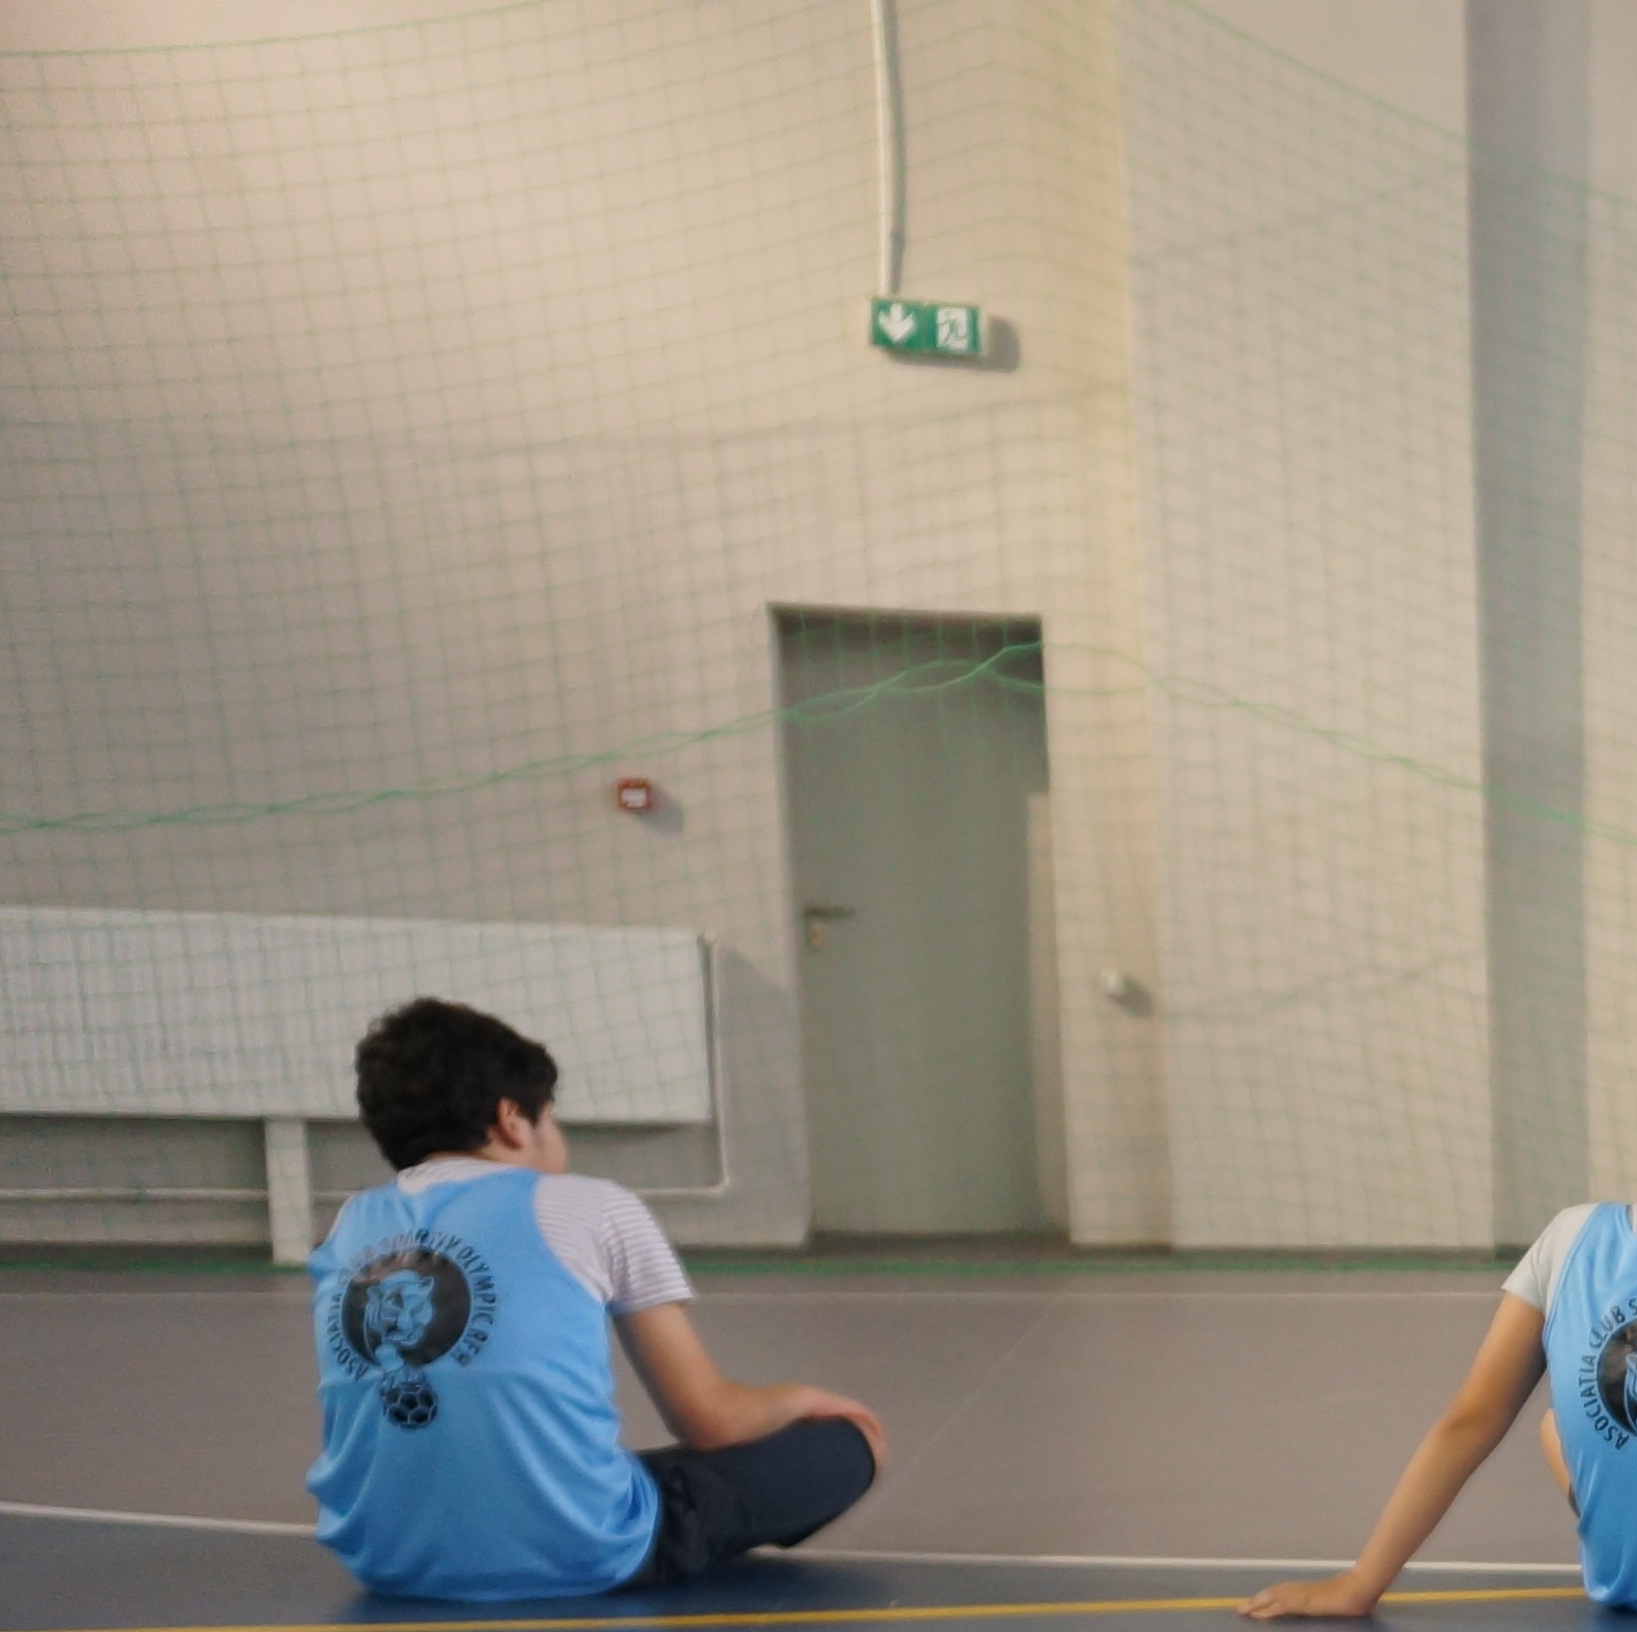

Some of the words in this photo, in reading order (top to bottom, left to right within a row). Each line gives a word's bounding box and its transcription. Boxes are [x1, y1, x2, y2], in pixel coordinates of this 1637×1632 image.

[456, 1246, 497, 1326] OLYMPIC
[1589, 1306, 1627, 1349] CLUB
[1578, 1355, 1630, 1451] ASOCIATIA
